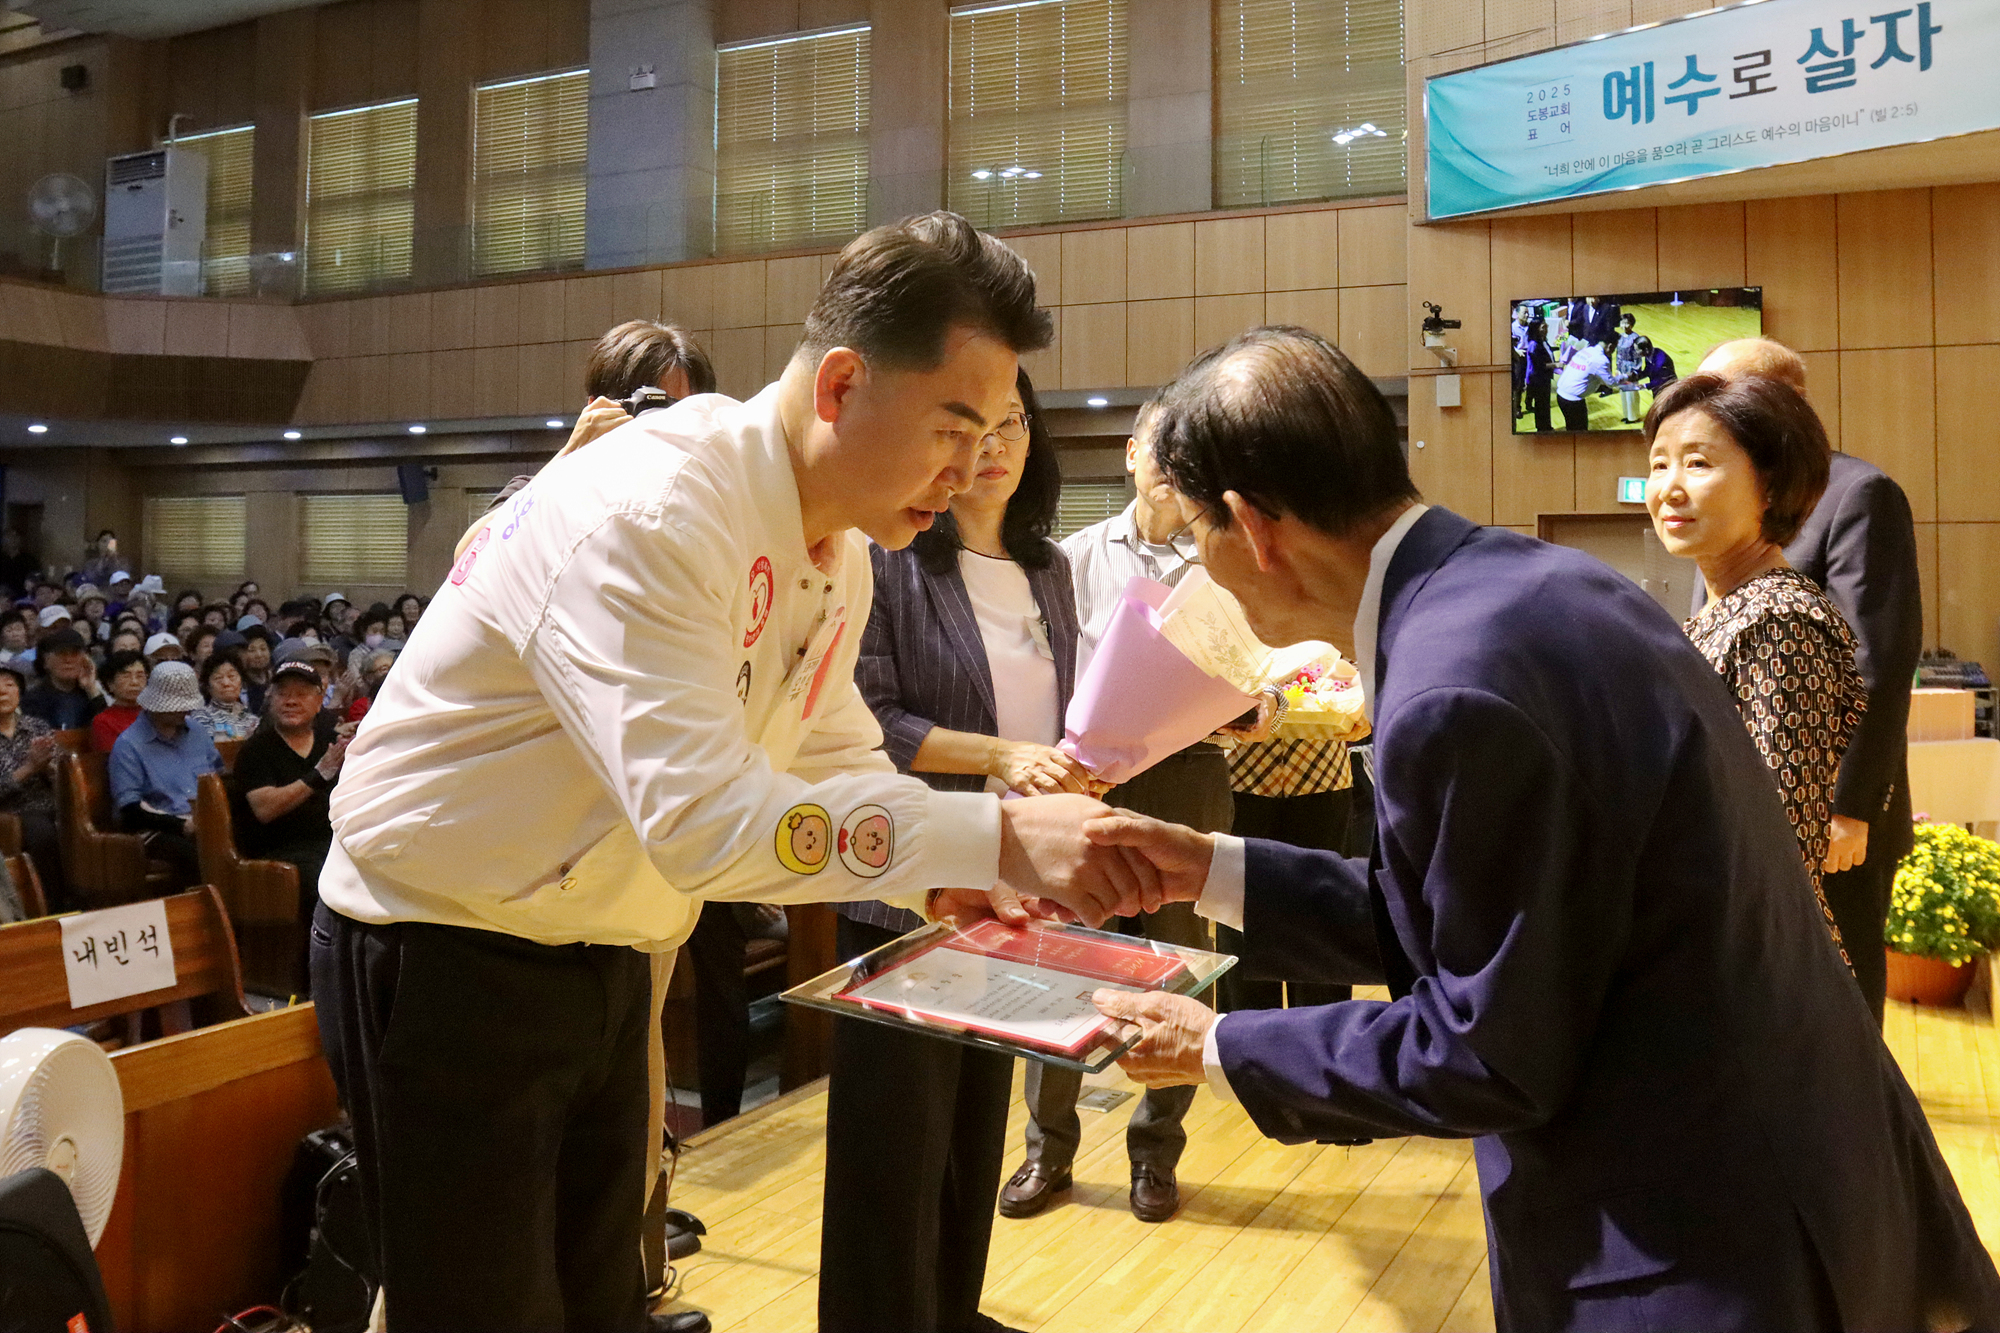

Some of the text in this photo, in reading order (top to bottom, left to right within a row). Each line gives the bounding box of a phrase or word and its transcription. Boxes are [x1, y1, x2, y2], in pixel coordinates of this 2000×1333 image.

[1603, 1, 1943, 125] 예수로 살자
[1527, 84, 1570, 104] 2025
[1527, 102, 1570, 122] 도봉교회
[1573, 158, 1595, 174] 안에
[1599, 155, 1610, 168] 이
[1614, 148, 1648, 165] 마음을
[1652, 142, 1688, 160] 품으라
[1691, 139, 1703, 154] 곧
[1706, 130, 1758, 150] 그리스도
[1762, 122, 1801, 142] 예수의
[1870, 107, 1887, 123] (빌
[1891, 102, 1918, 118] 2:5)
[72, 924, 159, 970] 내빈석
